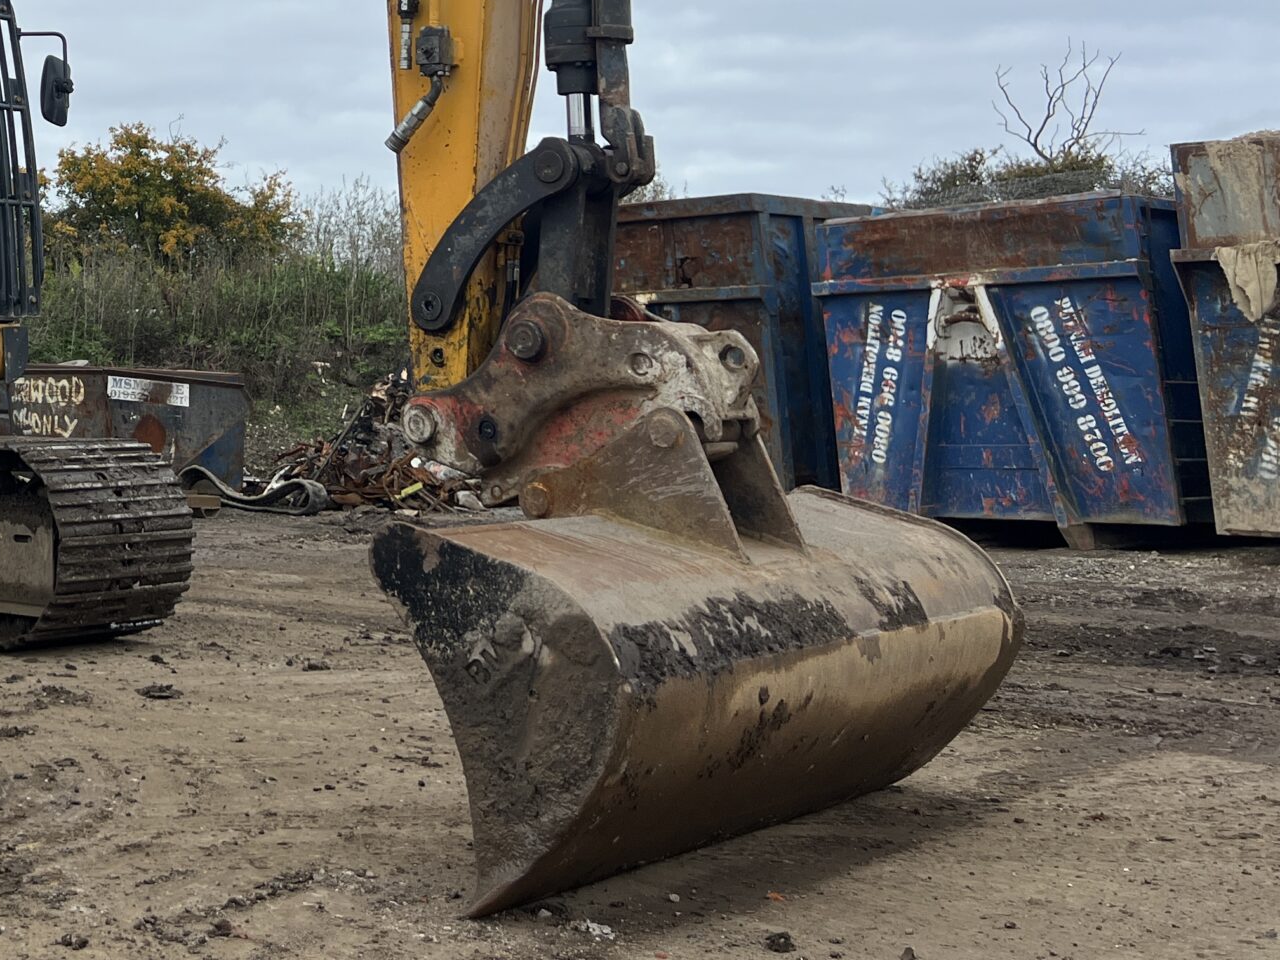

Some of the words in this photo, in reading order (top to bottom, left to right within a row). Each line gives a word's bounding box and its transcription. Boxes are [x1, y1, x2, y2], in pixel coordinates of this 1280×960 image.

[30, 376, 85, 407] WOOD
[878, 366, 899, 407] 999
[1030, 306, 1066, 362] 0800
[1056, 366, 1087, 409] 999
[1076, 414, 1114, 471] 8700
[32, 412, 78, 439] ONLY
[871, 410, 892, 464] 0800
